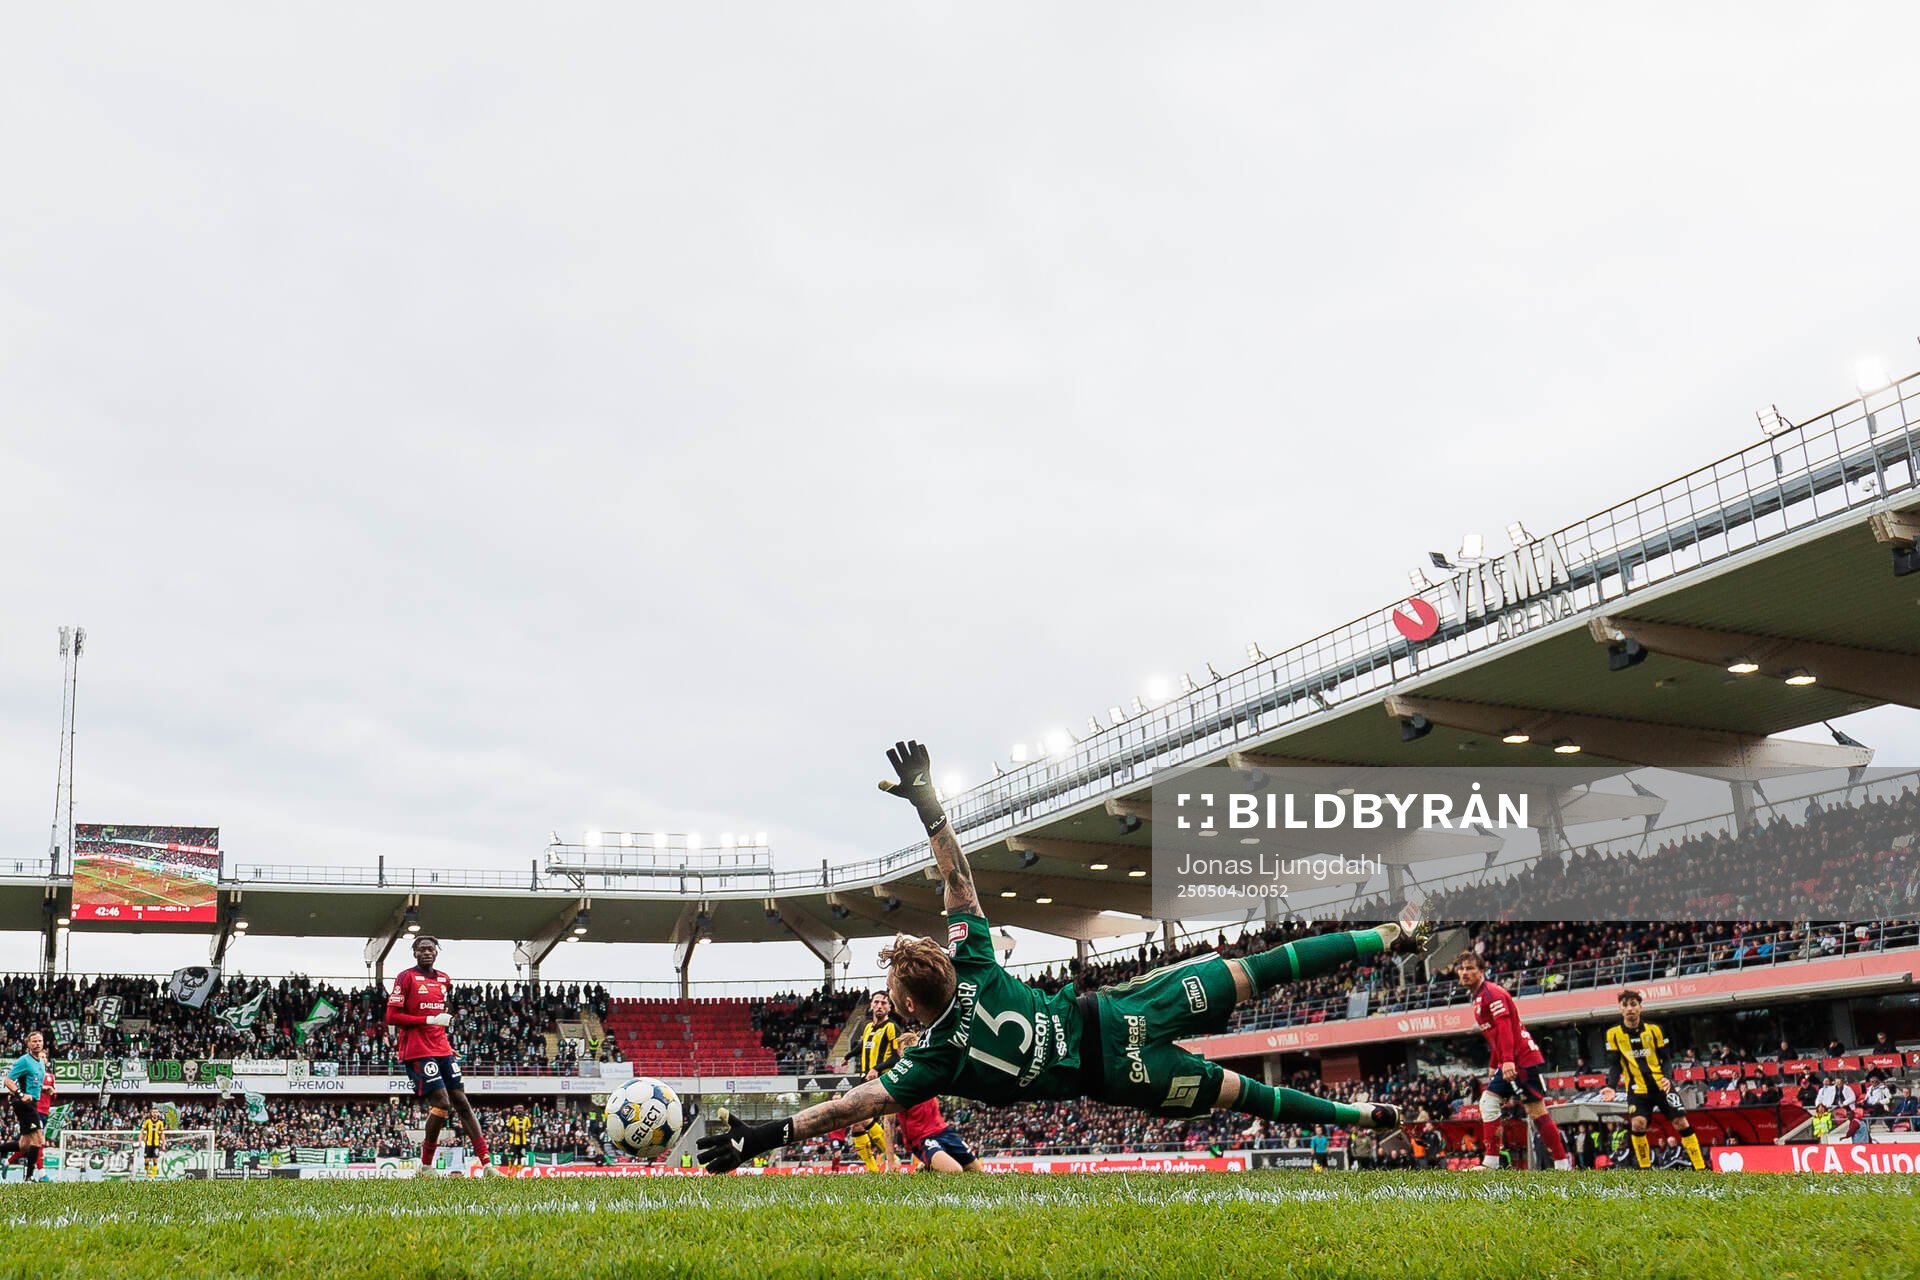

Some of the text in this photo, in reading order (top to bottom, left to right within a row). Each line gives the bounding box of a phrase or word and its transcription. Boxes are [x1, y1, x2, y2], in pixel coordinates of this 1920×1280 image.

[1446, 534, 1570, 625] VISMA
[1497, 590, 1578, 642] ARENA
[1019, 1012, 1049, 1088] dynacon
[1124, 1015, 1144, 1083] GoAhead
[83, 1080, 140, 1090] PRMON
[187, 1080, 243, 1090] PREN
[289, 1080, 345, 1090] PREMON
[631, 1106, 661, 1144] SELECT
[517, 1167, 542, 1178] CA
[1792, 1145, 1844, 1173] ICA
